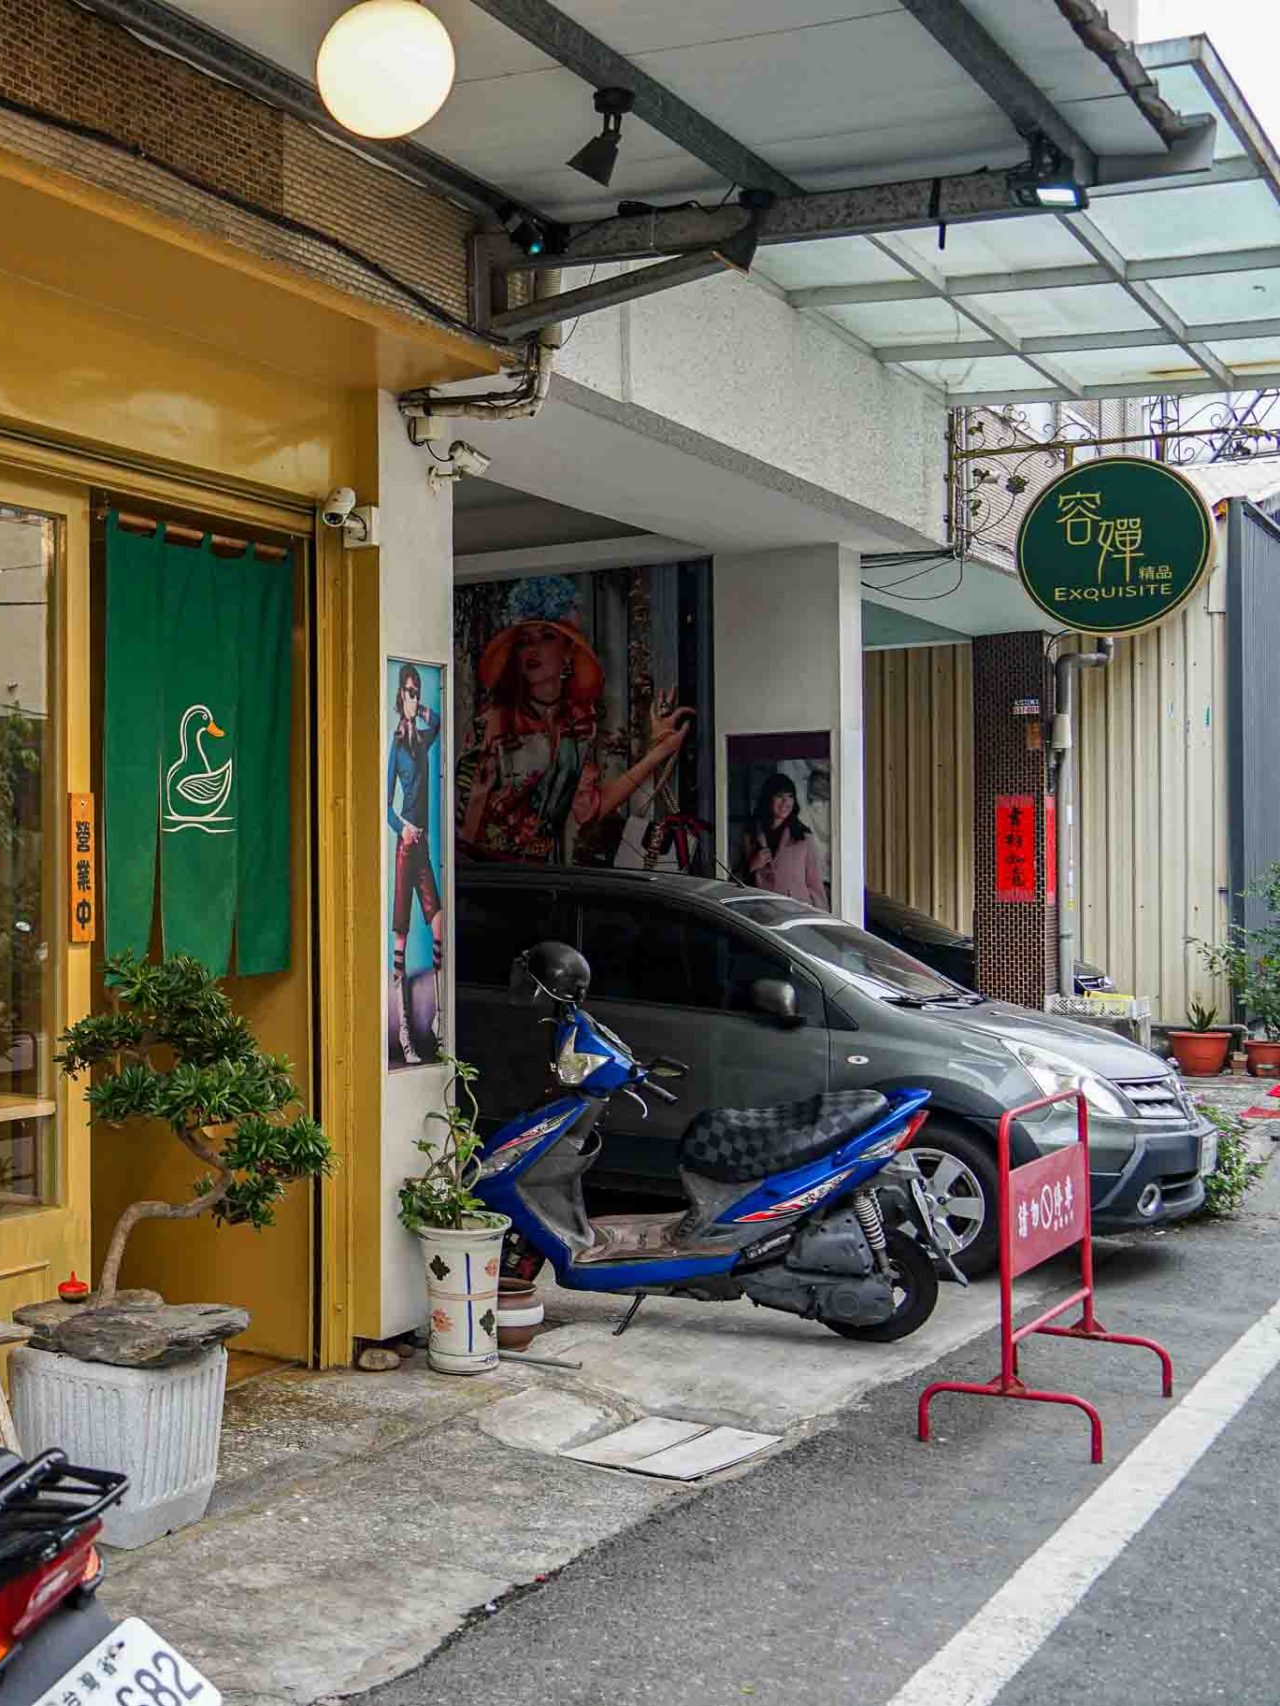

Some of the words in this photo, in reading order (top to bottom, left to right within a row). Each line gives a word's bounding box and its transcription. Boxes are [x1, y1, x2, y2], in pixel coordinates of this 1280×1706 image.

[1139, 565, 1173, 581] 精品
[1054, 583, 1173, 603] EXQUISITE
[75, 820, 92, 930] 營業中
